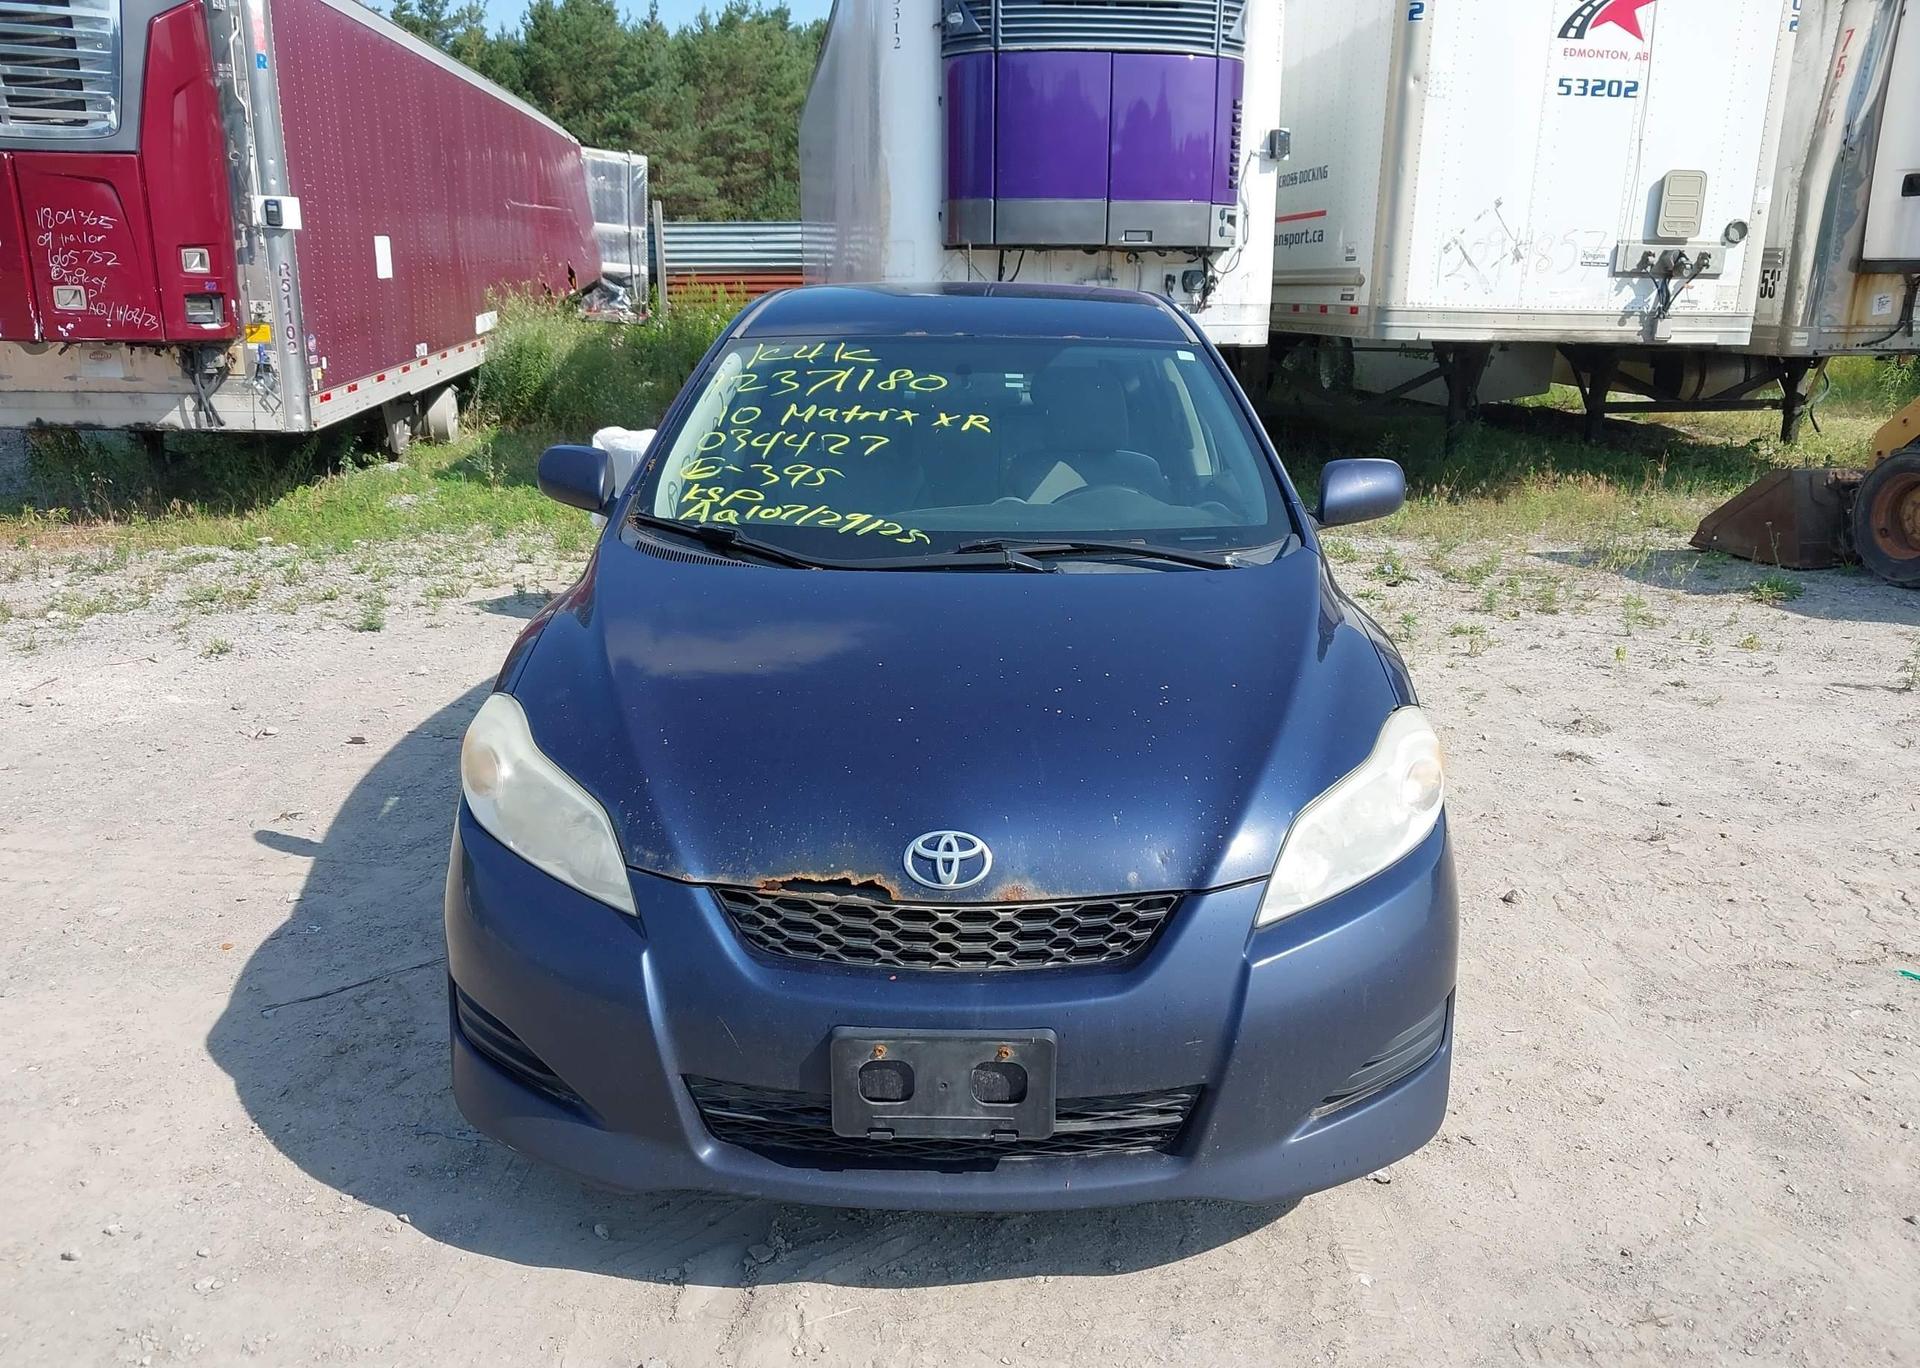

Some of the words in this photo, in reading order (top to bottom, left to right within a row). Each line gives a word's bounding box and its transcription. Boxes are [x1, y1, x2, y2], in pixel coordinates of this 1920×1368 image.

[892, 0, 901, 49] 312
[1563, 47, 1632, 62] EDMONTON,
[1634, 51, 1649, 61] AB
[1557, 77, 1639, 99] 53202
[1279, 171, 1298, 189] CROSS
[1299, 164, 1329, 184] DOCKING
[278, 262, 298, 356] R51102
[780, 403, 920, 427] Matrix
[696, 428, 890, 459] 034427
